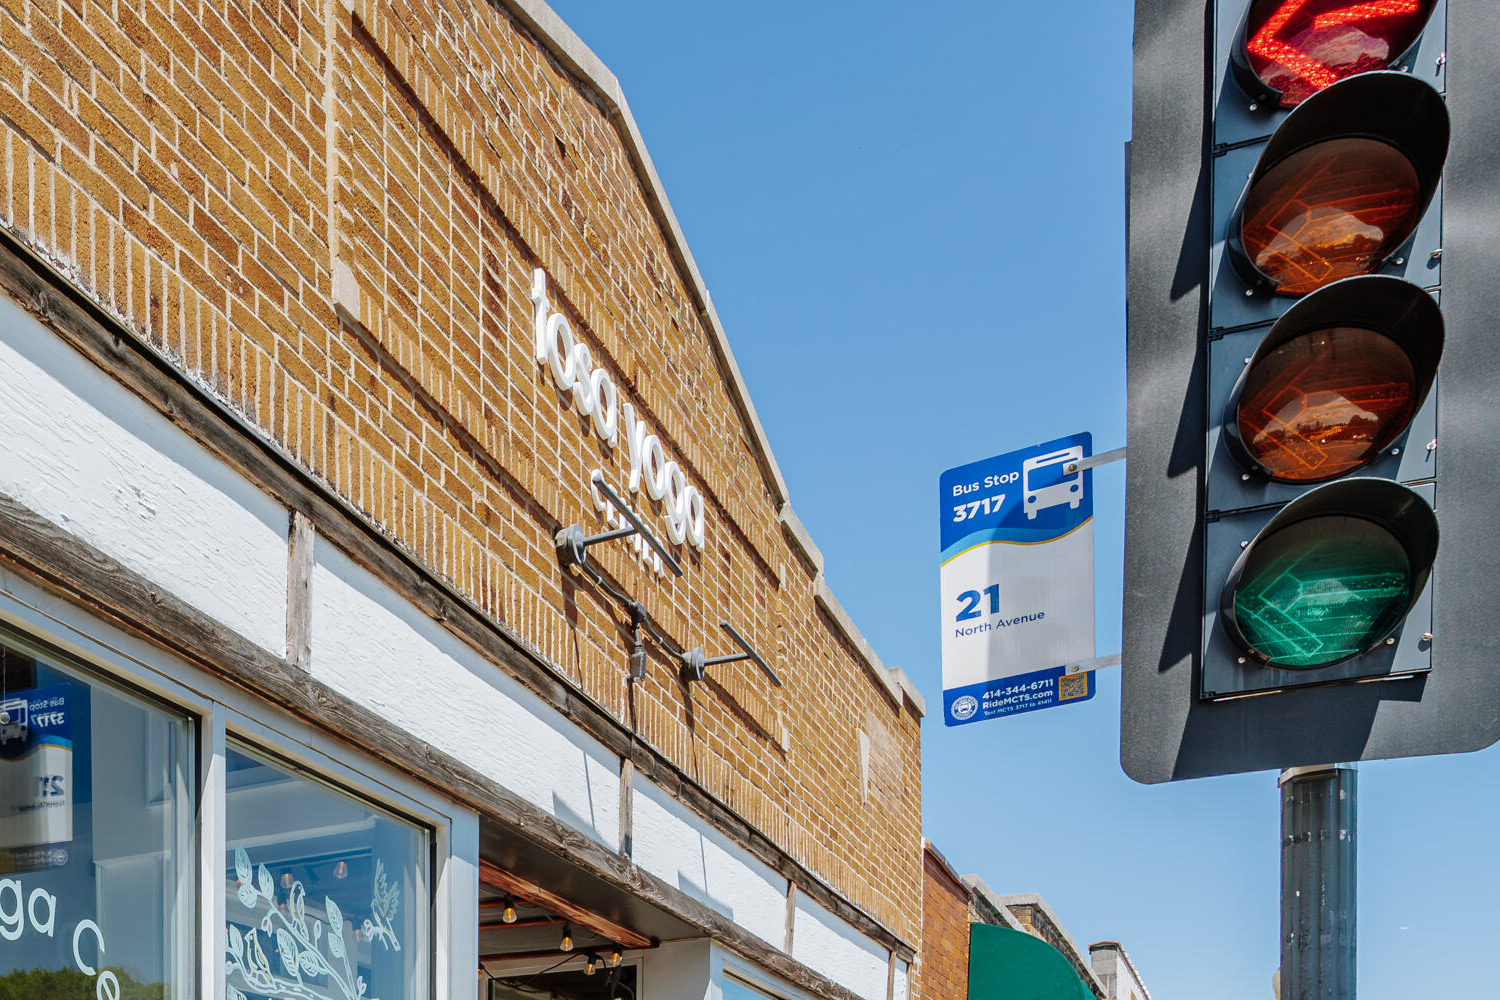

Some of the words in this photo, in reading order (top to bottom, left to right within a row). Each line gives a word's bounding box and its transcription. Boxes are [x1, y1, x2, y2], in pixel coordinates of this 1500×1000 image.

[531, 267, 617, 448] tosa
[623, 403, 704, 551] yoga
[952, 481, 980, 497] Bus
[984, 471, 1020, 489] Stop
[952, 493, 1006, 523] 3717
[955, 583, 1000, 622] 21
[955, 621, 992, 638] North
[995, 611, 1045, 628] Avenue
[982, 679, 1054, 700] 414-344-6711
[982, 690, 1053, 709] RideMCTS.com
